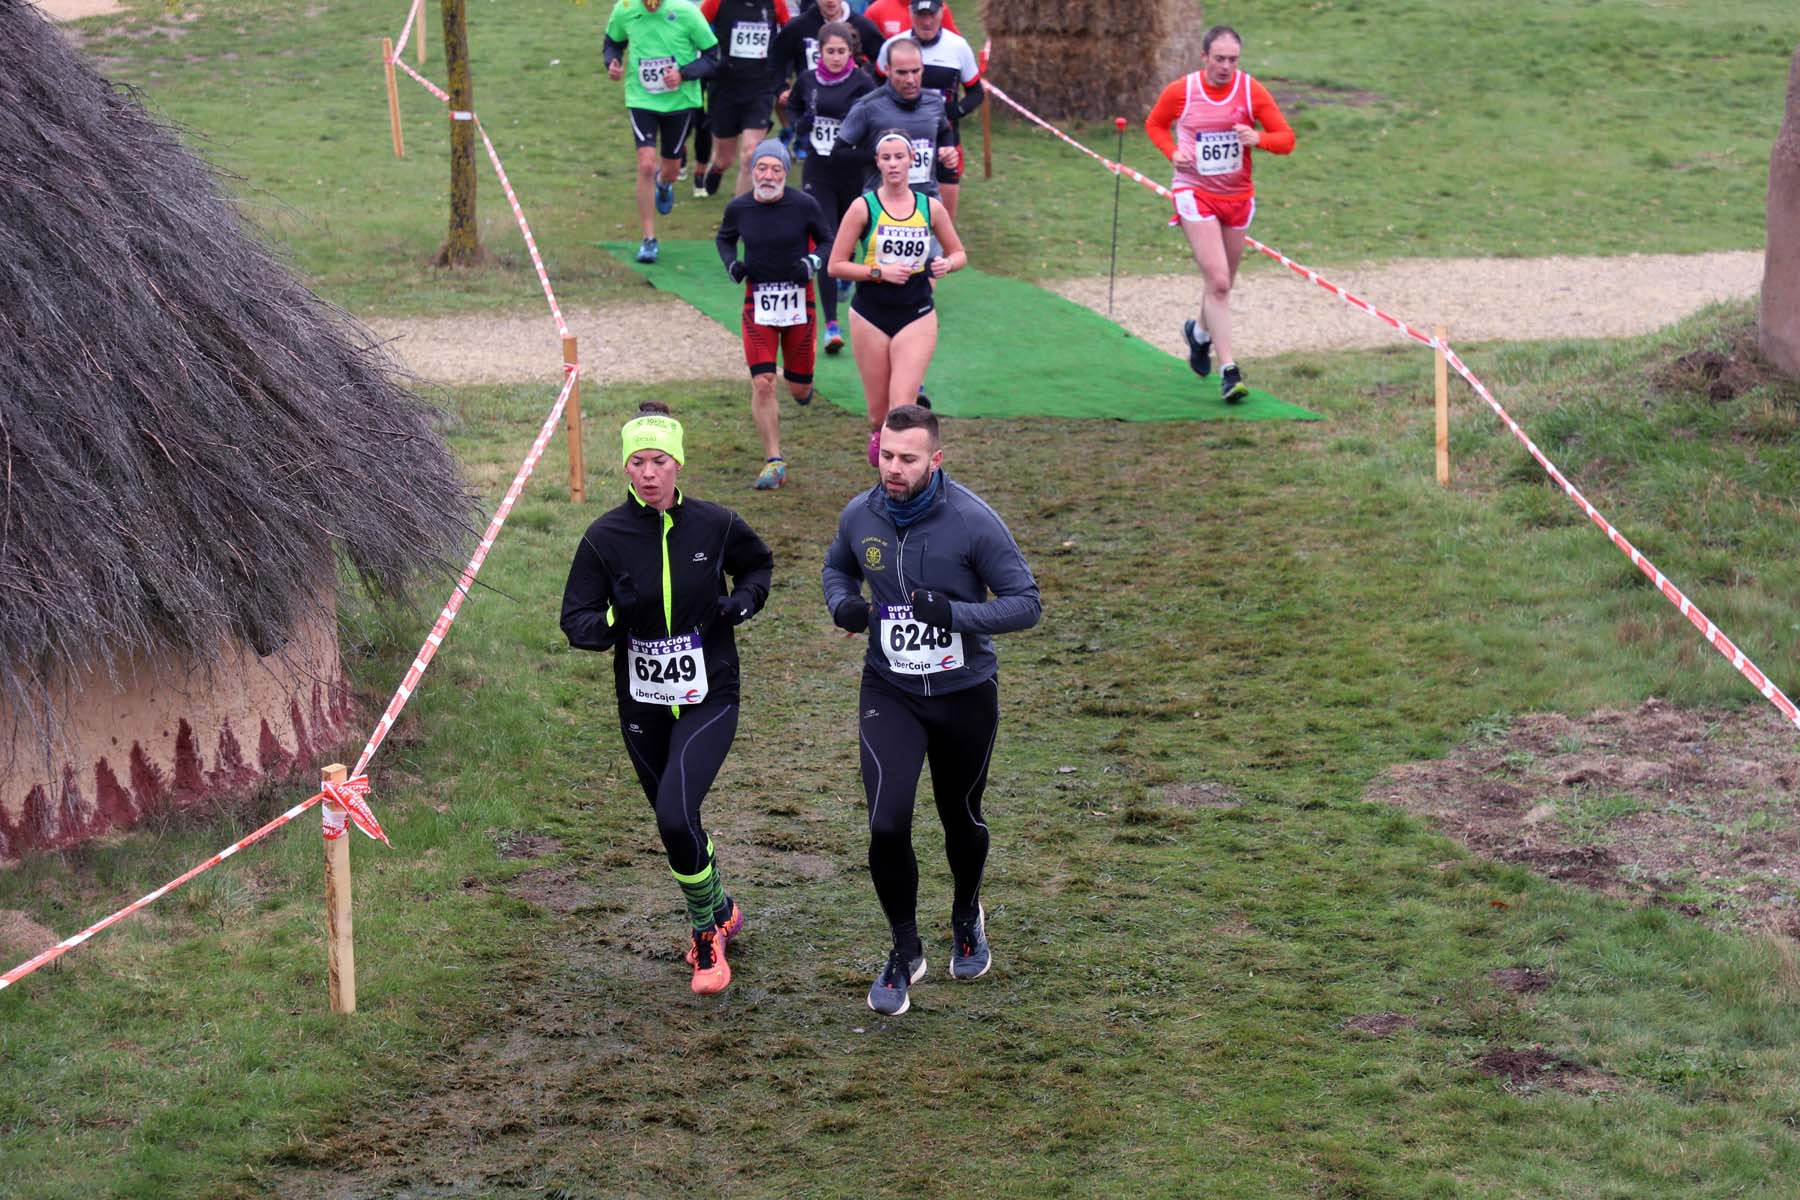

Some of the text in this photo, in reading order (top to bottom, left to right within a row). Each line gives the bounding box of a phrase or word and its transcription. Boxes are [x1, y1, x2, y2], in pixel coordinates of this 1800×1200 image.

[909, 152, 929, 168] 96
[1203, 142, 1239, 161] 6673
[882, 239, 925, 257] 6389
[761, 291, 798, 311] 6711
[631, 635, 691, 649] DIPUTACIÓN
[890, 623, 953, 652] 6248
[632, 642, 693, 655] BURGOS
[634, 655, 697, 684] 6249
[635, 688, 676, 703] iberCaja
